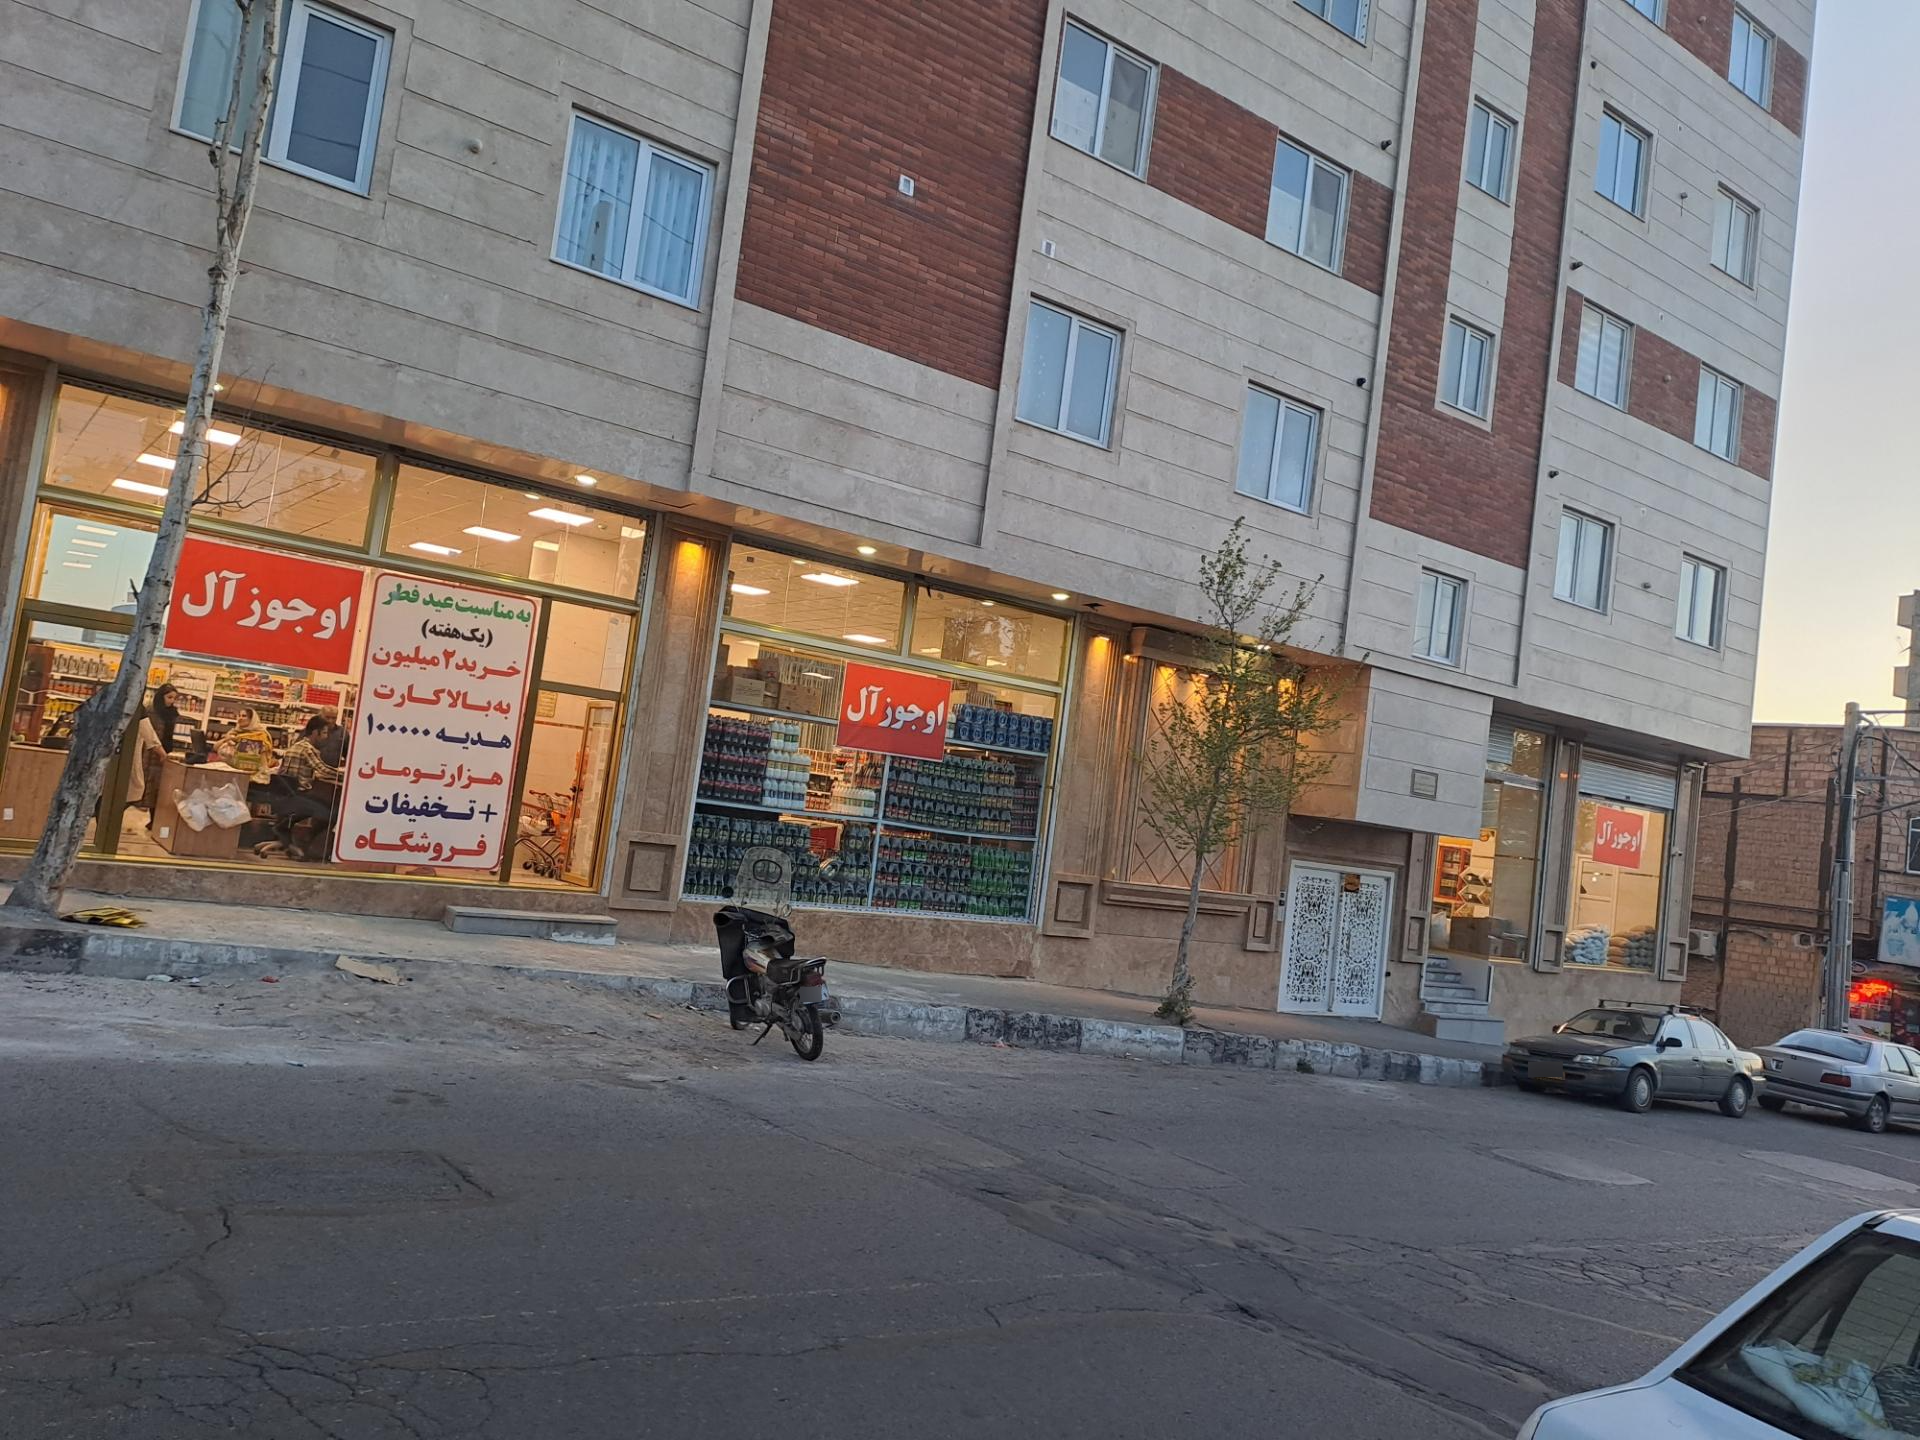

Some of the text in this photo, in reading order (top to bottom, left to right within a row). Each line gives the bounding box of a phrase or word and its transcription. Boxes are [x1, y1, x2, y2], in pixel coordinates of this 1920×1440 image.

[181, 569, 352, 640] اوجوز آل
[382, 583, 532, 628] به مناسبت عید فطر
[372, 645, 441, 671] میلیون
[455, 657, 521, 679] خرید
[373, 683, 446, 708] کارت
[446, 689, 492, 717] بالا
[492, 699, 511, 720] به
[846, 685, 884, 722] آل
[367, 713, 512, 750] هدیه ۱۰۰۰۰۰
[877, 696, 945, 735] اوجوز
[358, 756, 503, 789] هزار تومان
[365, 792, 477, 823] تخفیفات
[355, 828, 487, 863] فروشگاه
[1597, 820, 1640, 852] اوجوز آل
